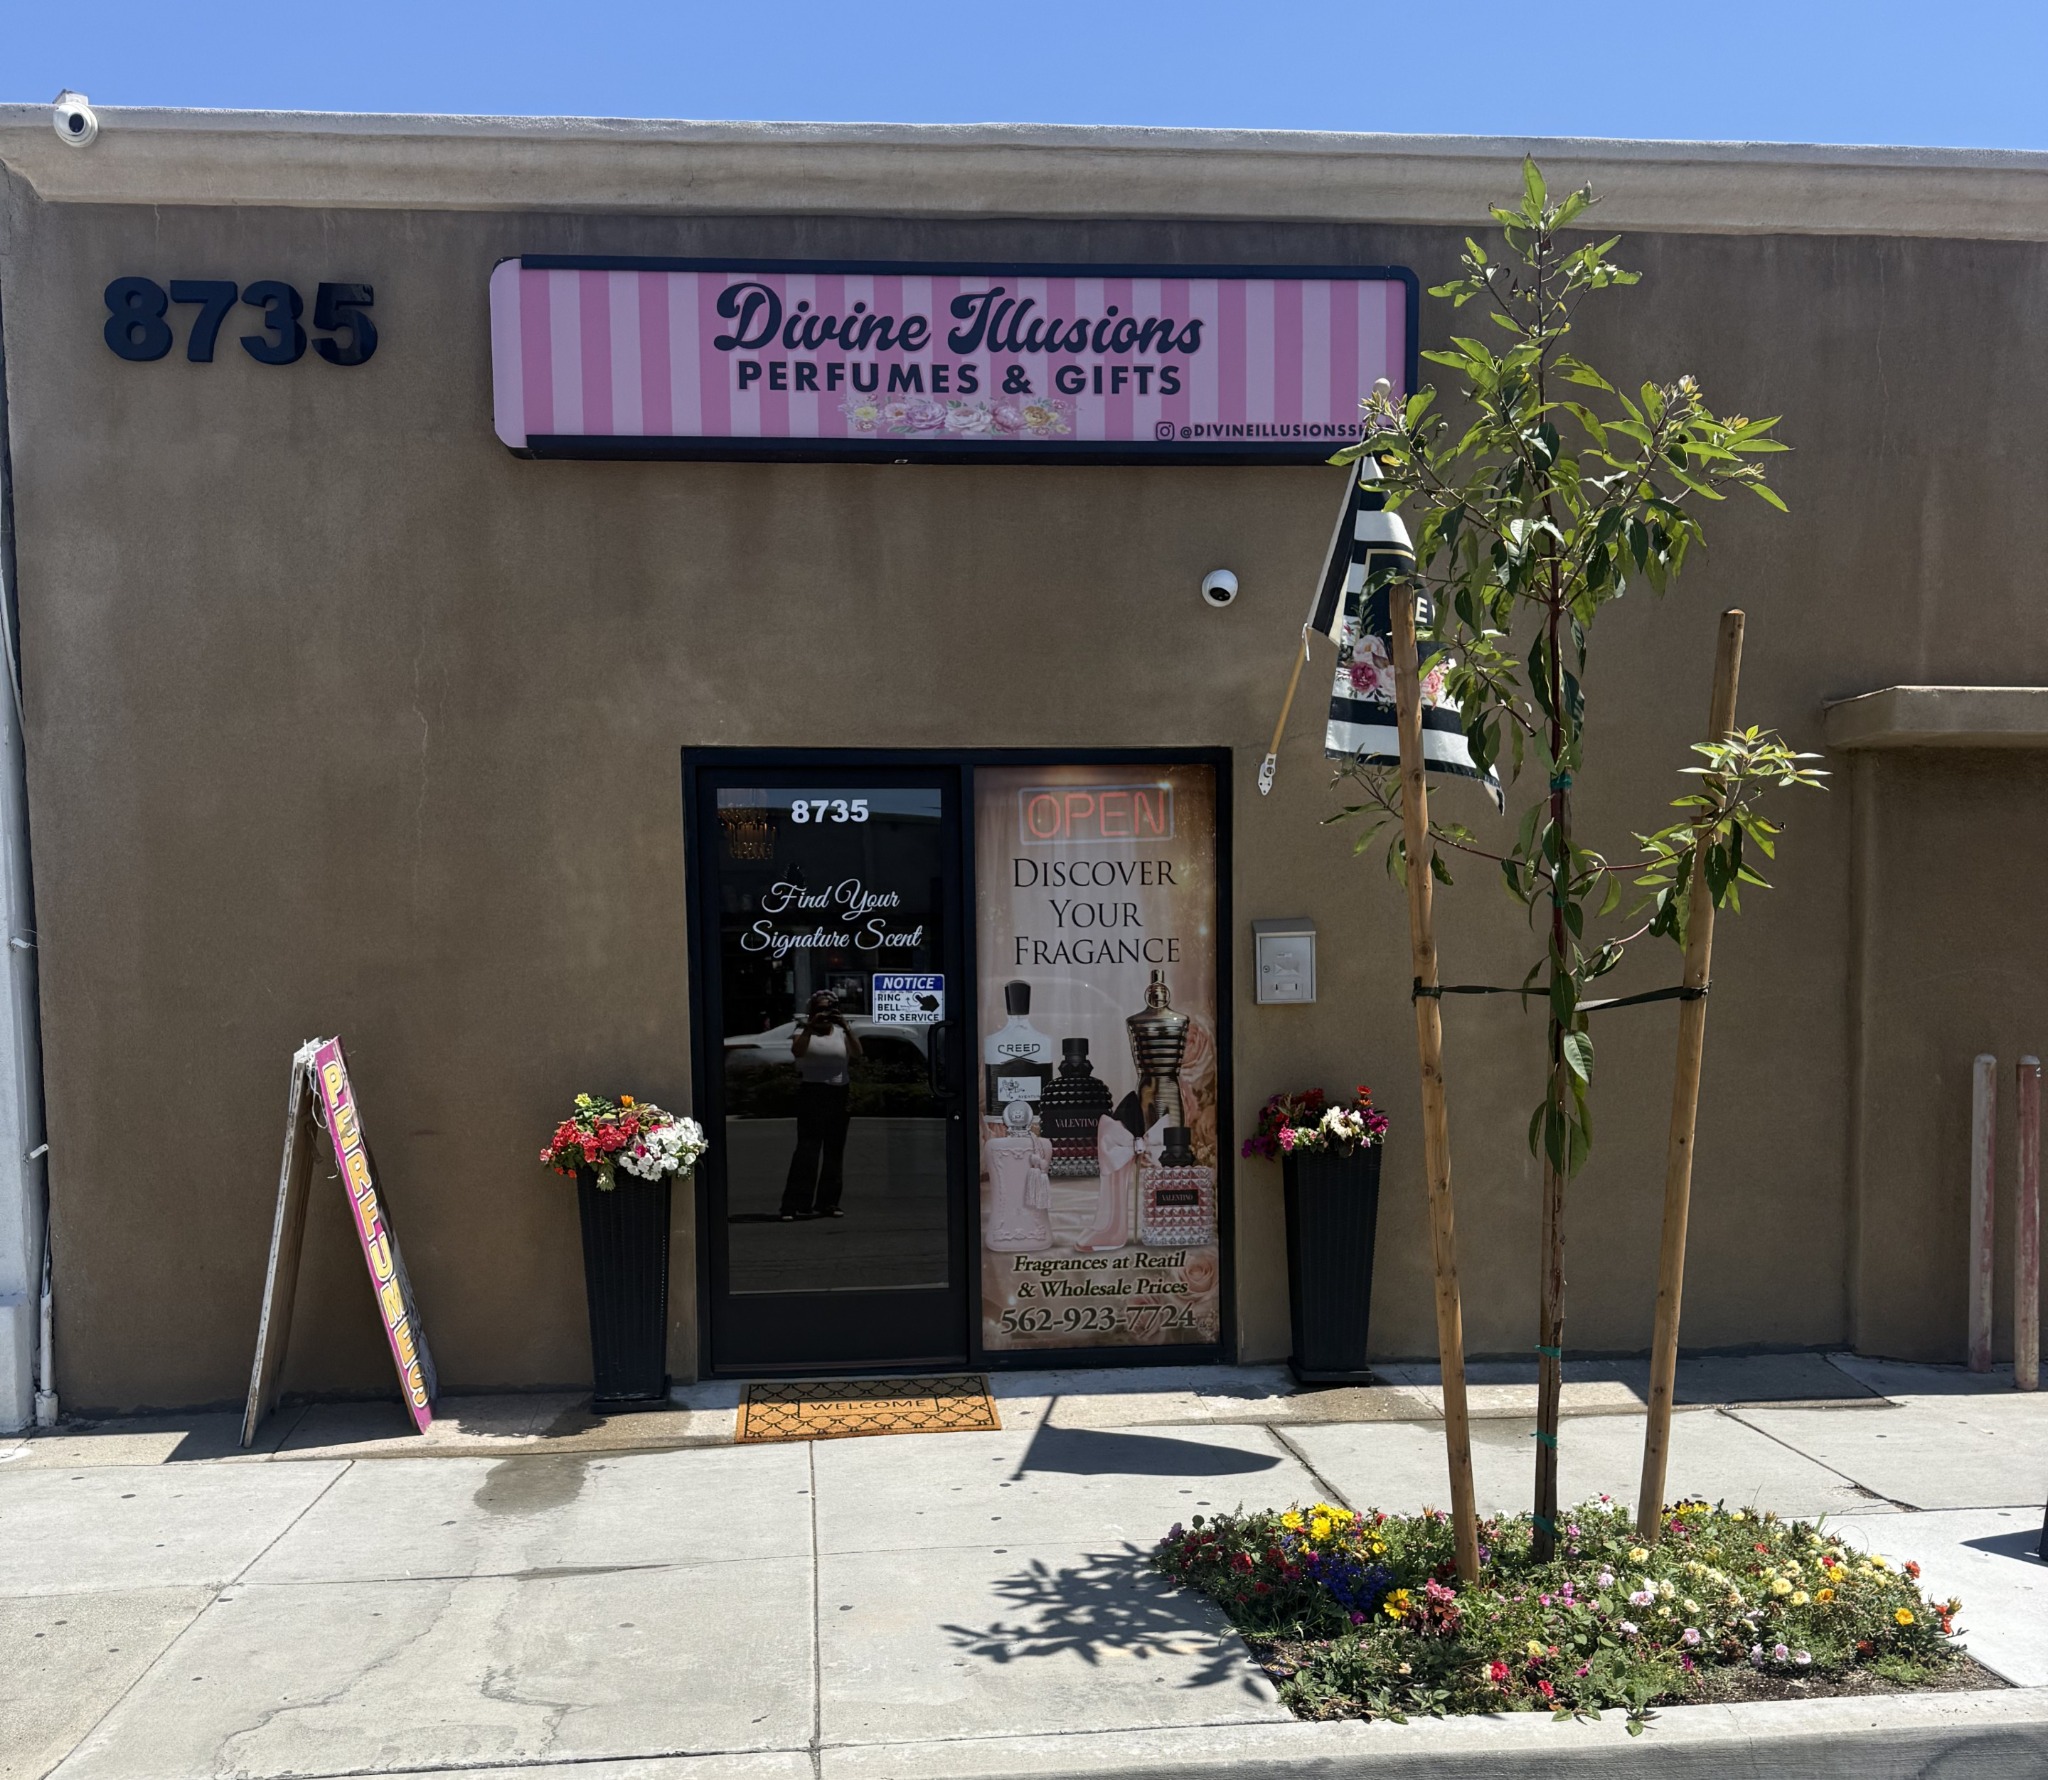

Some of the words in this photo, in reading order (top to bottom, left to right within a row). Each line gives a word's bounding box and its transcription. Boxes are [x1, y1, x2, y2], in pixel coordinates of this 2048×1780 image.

[104, 276, 378, 366] 8735
[713, 282, 931, 351] Divine
[947, 286, 1204, 354] Illusions
[738, 361, 979, 394] PERFUMES
[1002, 364, 1032, 395] &
[1055, 365, 1181, 395] GIFTS
[791, 799, 869, 823] 8735
[1027, 791, 1165, 838] OPEN
[1012, 858, 1177, 888] DISCOVER
[762, 882, 832, 913] Find
[834, 878, 900, 920] Your
[1049, 899, 1143, 928] YOUR
[741, 920, 849, 958] Signature
[854, 918, 923, 950] Scent
[1014, 936, 1180, 965] FRAGANCE
[877, 993, 901, 1001] RING
[882, 977, 935, 989] NOTICE
[877, 1003, 901, 1011] BELL
[877, 1013, 896, 1021] FOR
[899, 1013, 939, 1021] SERVICE
[998, 1044, 1040, 1056] CREED
[1055, 1118, 1098, 1128] VALENTINO
[322, 1061, 430, 1407] PERFUMES
[1013, 1255, 1107, 1276] Fragrances
[1112, 1257, 1130, 1269] at
[1134, 1251, 1186, 1268] Reatil
[1017, 1282, 1036, 1298] &
[1040, 1279, 1131, 1297] Wholesale
[1137, 1279, 1189, 1295] Prices
[1001, 1303, 1196, 1334] 562-923-7724
[810, 1399, 927, 1411] WELCOME
